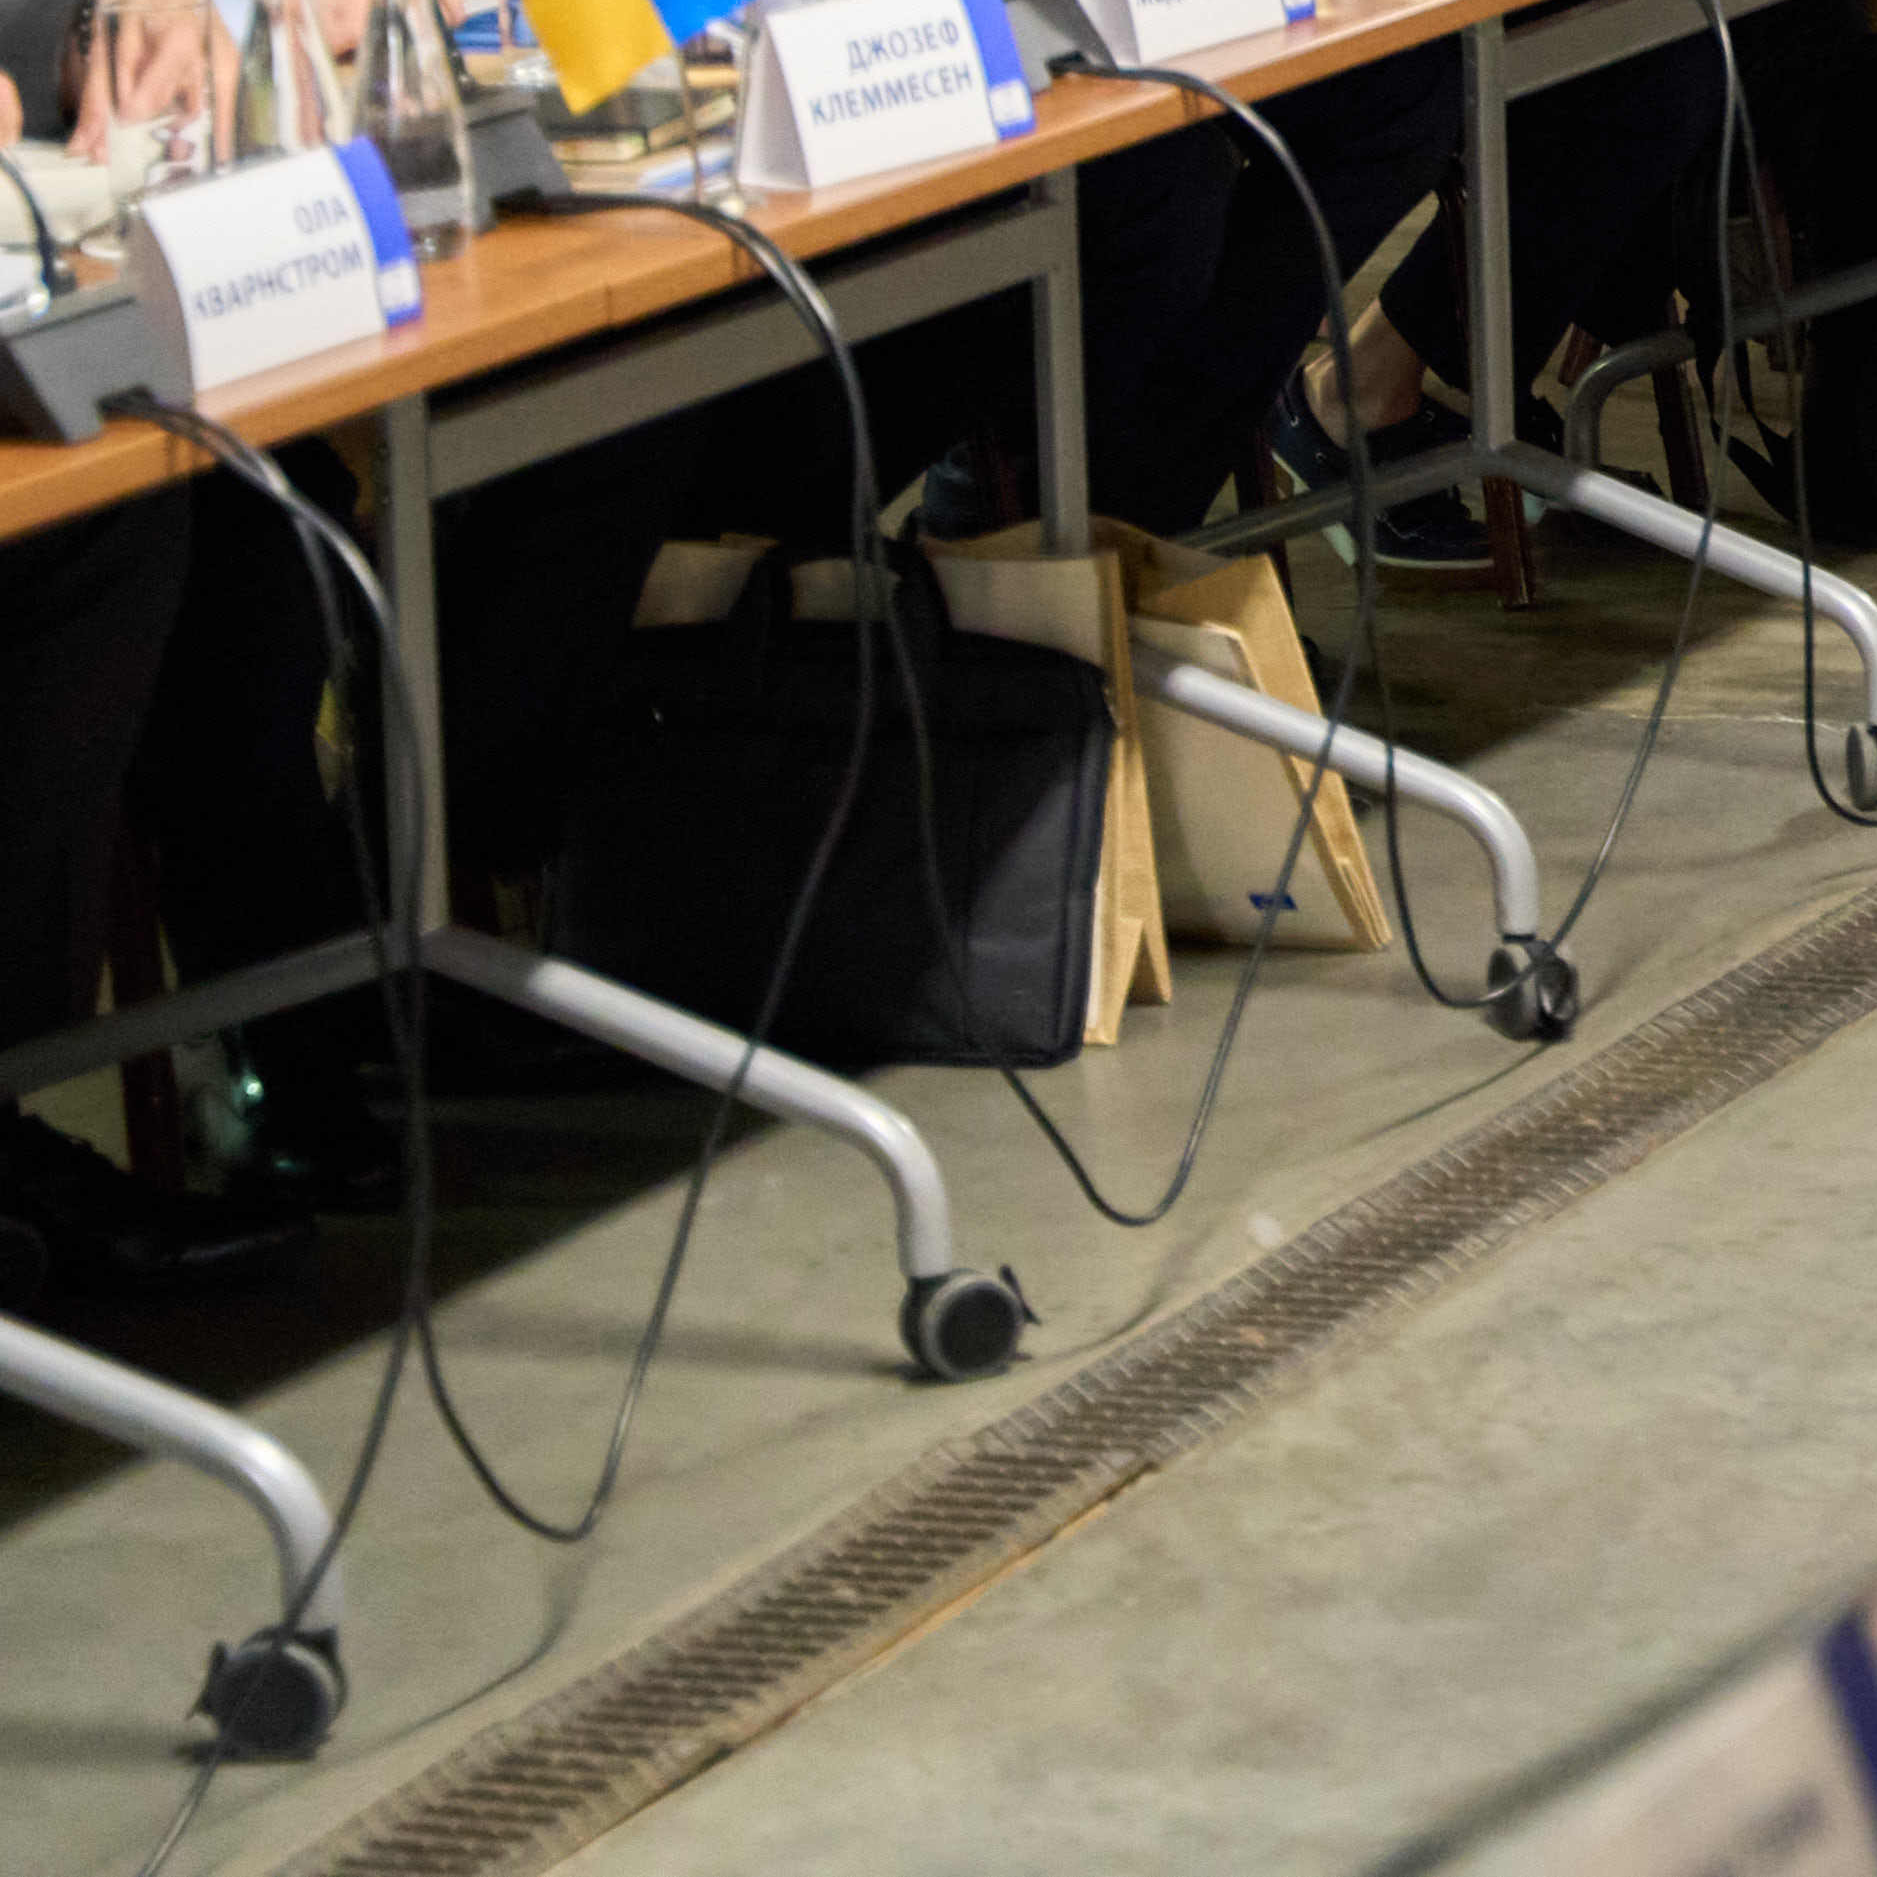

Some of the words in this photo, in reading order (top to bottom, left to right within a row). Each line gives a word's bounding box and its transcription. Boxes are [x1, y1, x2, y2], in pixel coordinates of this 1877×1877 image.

[847, 18, 961, 74] ДЖОЗЕФ
[808, 60, 975, 125] КЛЕММЕСЕН
[293, 195, 350, 235] ОЛА
